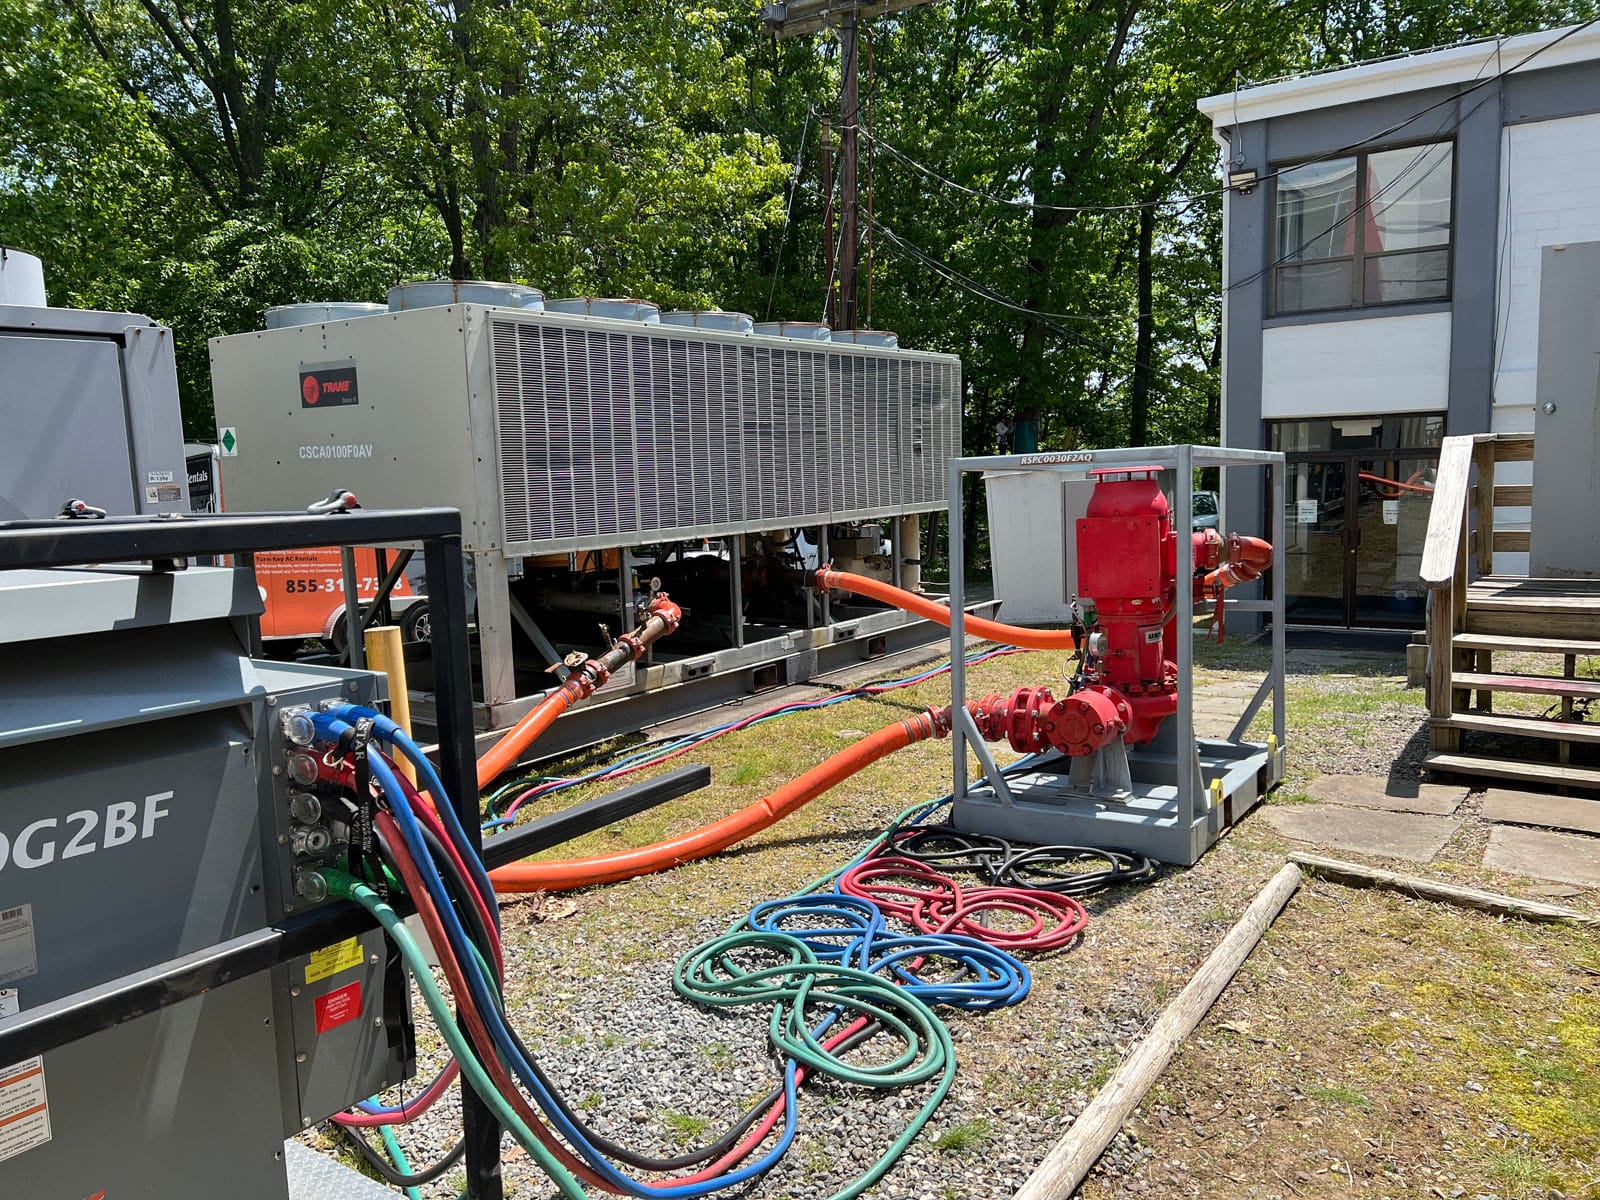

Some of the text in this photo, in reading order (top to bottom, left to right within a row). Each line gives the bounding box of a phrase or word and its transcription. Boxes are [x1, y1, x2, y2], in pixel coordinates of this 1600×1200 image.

[322, 380, 352, 393] TRANE
[299, 444, 373, 459] CSCA0100F0AV
[187, 470, 208, 484] entals
[286, 577, 402, 593] 855-31-738
